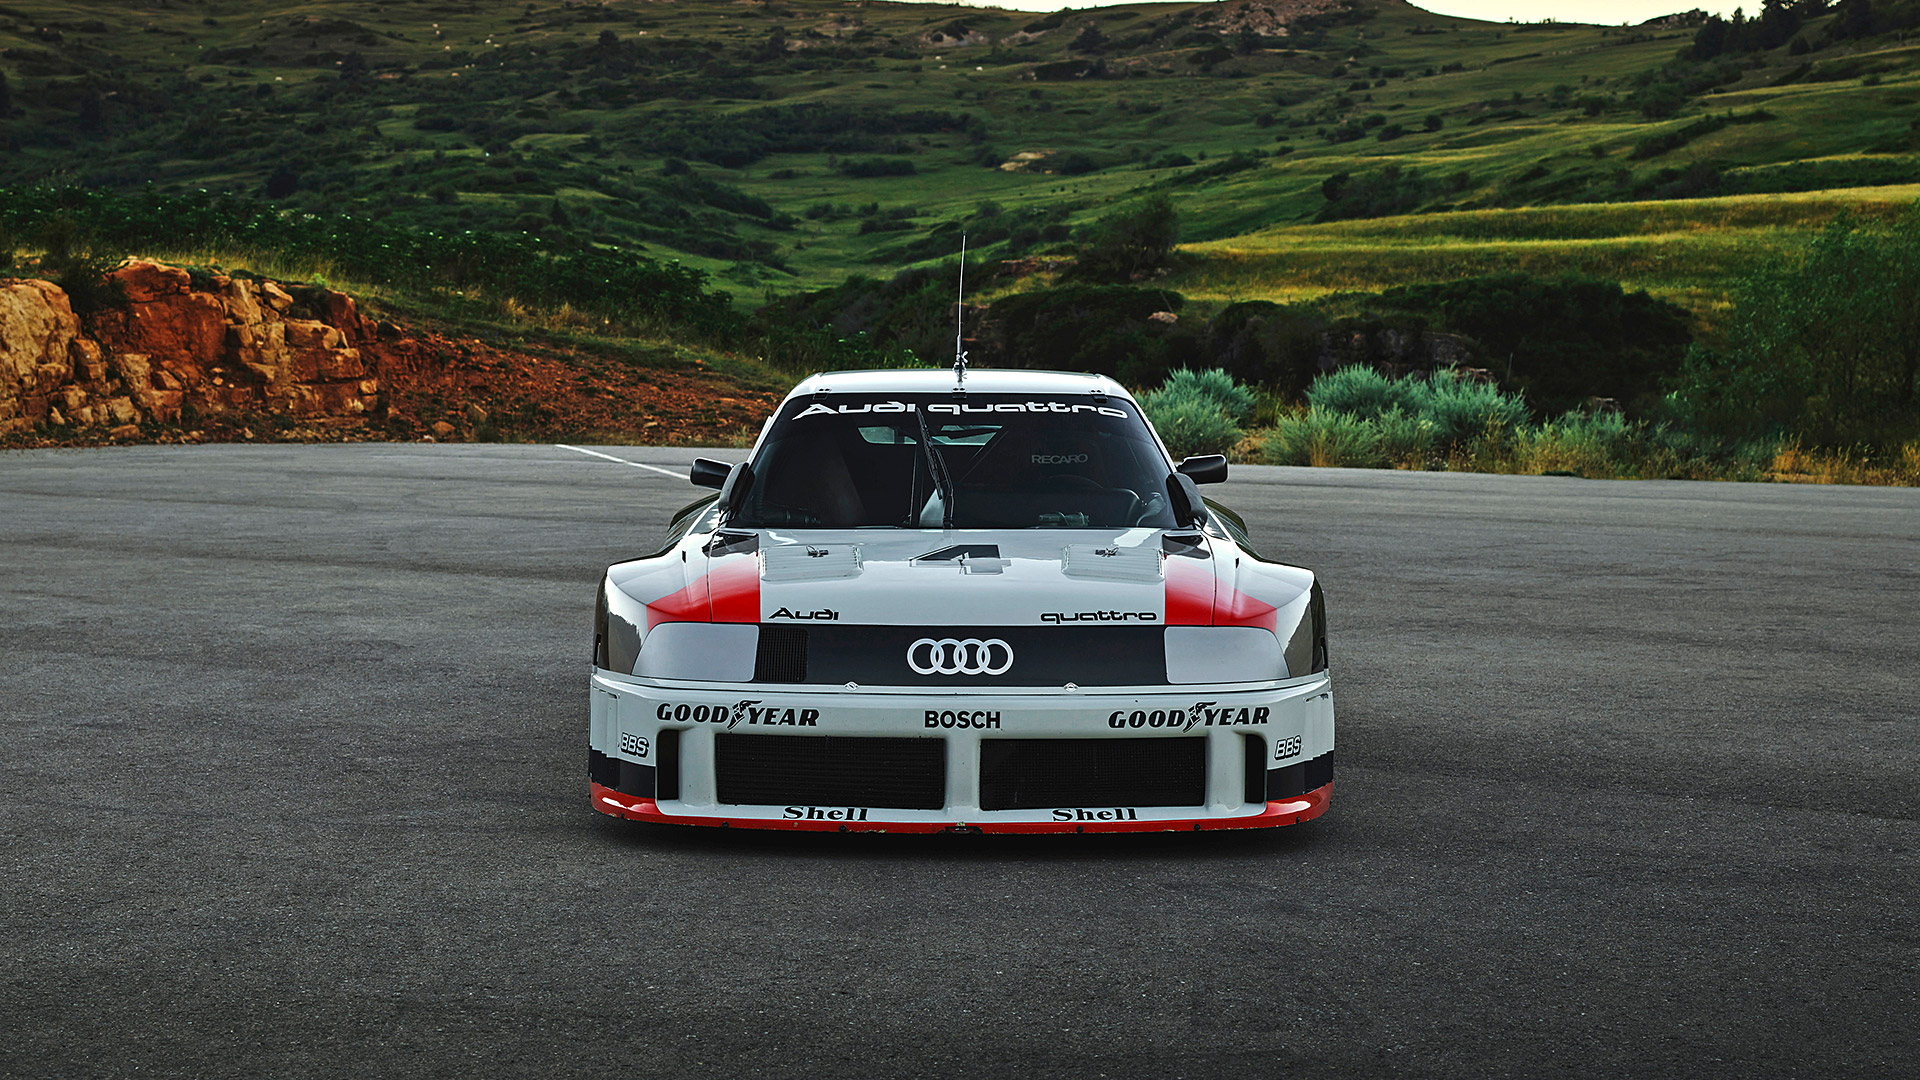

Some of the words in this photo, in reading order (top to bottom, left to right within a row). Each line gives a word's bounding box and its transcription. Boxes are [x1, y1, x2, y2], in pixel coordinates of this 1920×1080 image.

[792, 401, 916, 420] Audi
[928, 402, 1128, 418] quattro
[1031, 453, 1088, 464] RECARO
[909, 544, 1012, 576] 4
[770, 607, 840, 621] Audi
[1040, 610, 1158, 624] quattro
[924, 710, 1001, 729] BOSCH
[620, 732, 650, 758] BBS
[1274, 735, 1302, 760] BBS
[782, 806, 868, 822] Shell
[1052, 808, 1138, 822] Shell
